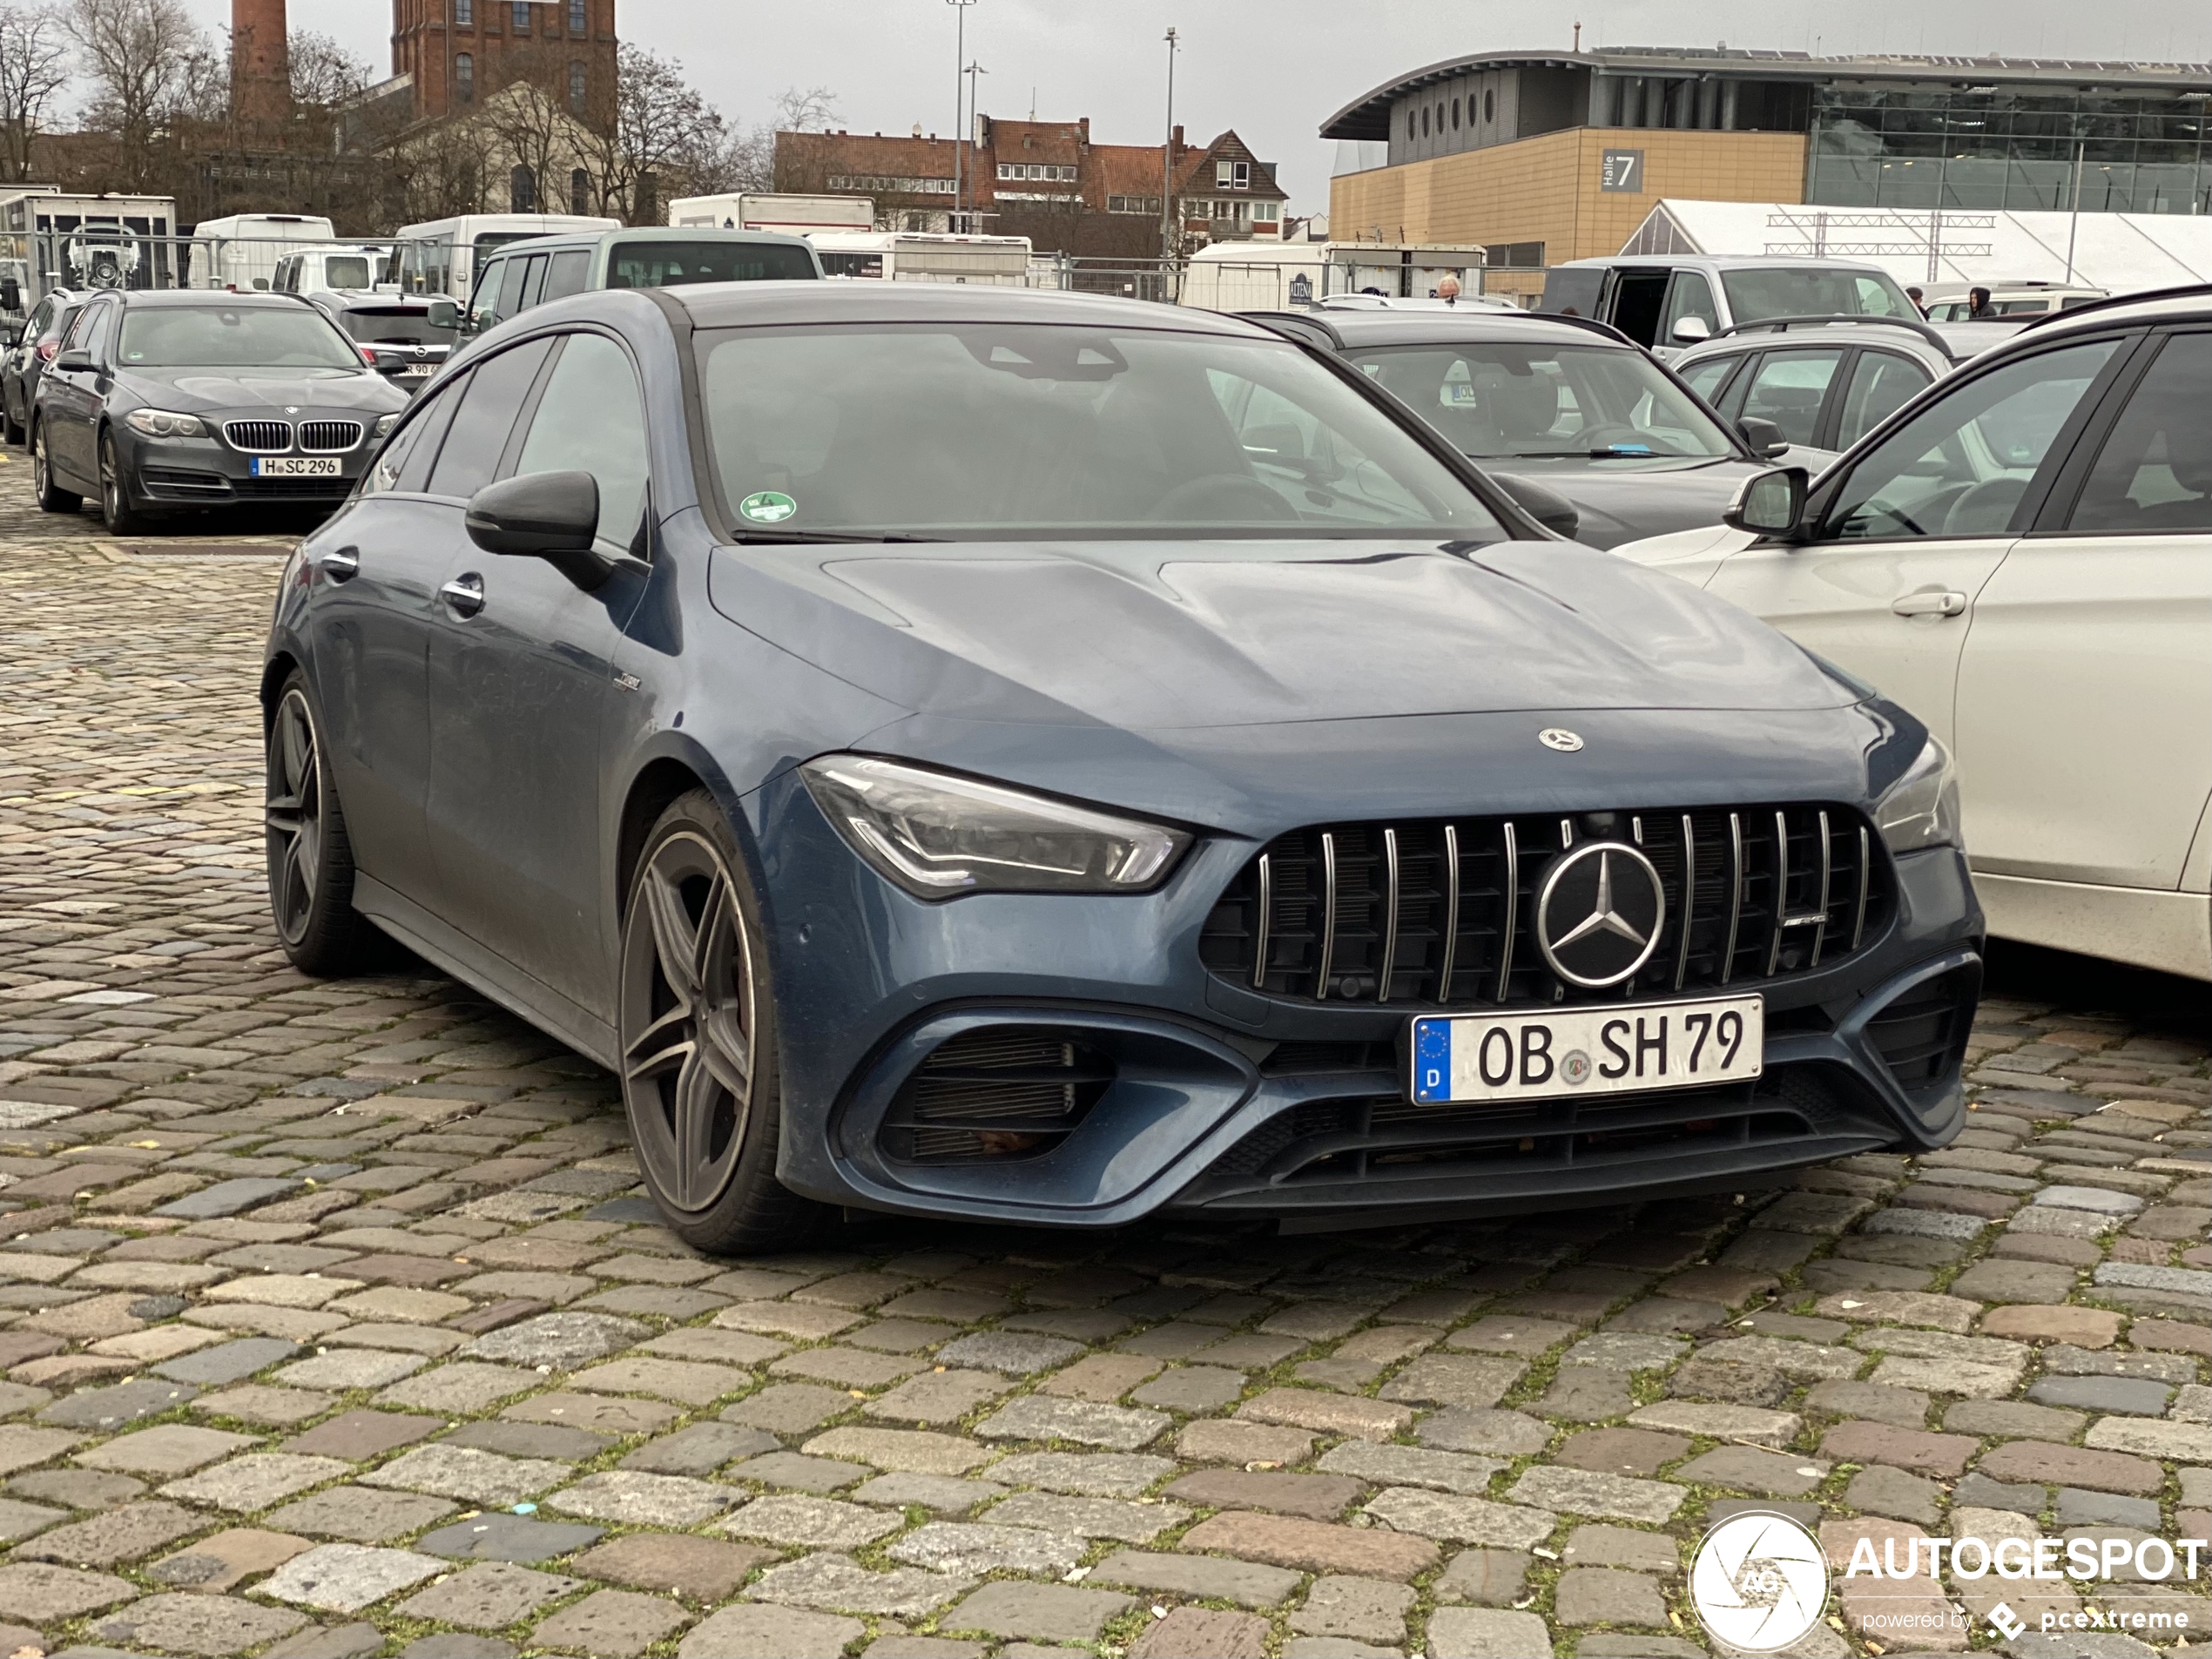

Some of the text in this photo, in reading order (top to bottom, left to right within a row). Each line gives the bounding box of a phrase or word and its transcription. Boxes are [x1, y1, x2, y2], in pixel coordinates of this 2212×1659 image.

[1602, 155, 1635, 185] Halle 7
[1289, 282, 1312, 297] ALTENA
[415, 364, 428, 374] 90
[265, 460, 335, 474] H SC 296
[759, 493, 774, 506] 4
[1478, 1024, 1554, 1088] OB
[1598, 1015, 1669, 1079] SH
[1684, 1009, 1744, 1073] 79
[1426, 1069, 1440, 1087] D
